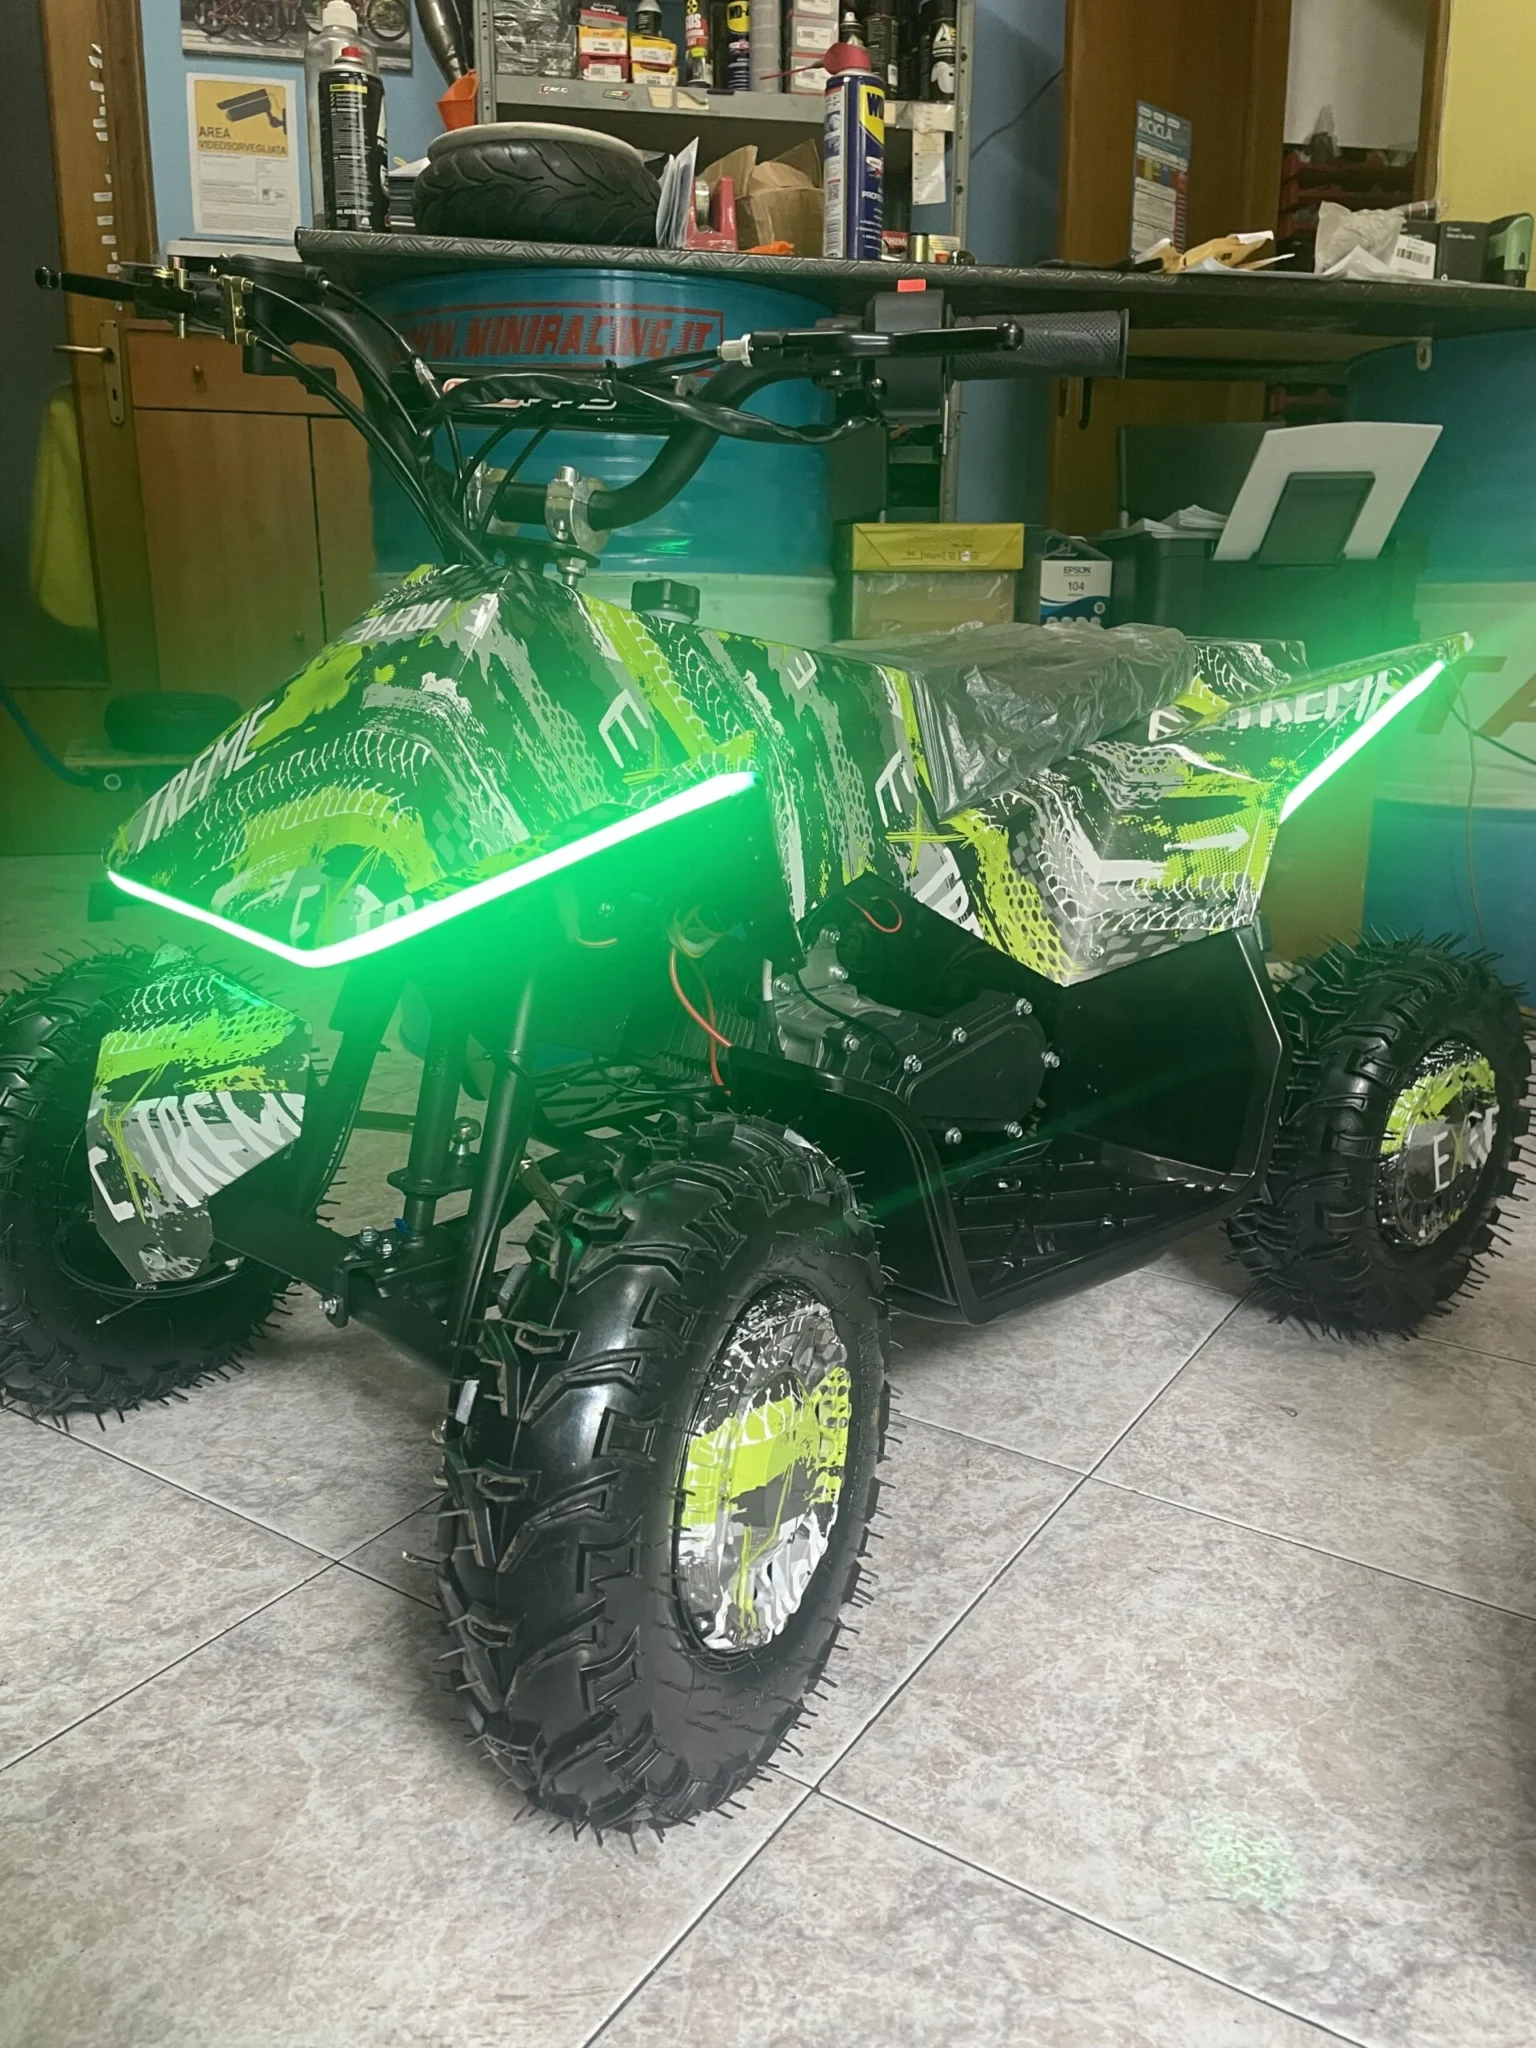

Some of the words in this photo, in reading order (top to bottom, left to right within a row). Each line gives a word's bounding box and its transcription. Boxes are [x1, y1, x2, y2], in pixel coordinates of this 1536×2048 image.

[728, 5, 750, 20] WD-
[198, 126, 231, 139] AREA
[199, 140, 288, 154] VIDEOSORVEGLIATA
[1063, 566, 1092, 574] EPSON
[1068, 581, 1085, 591] 104
